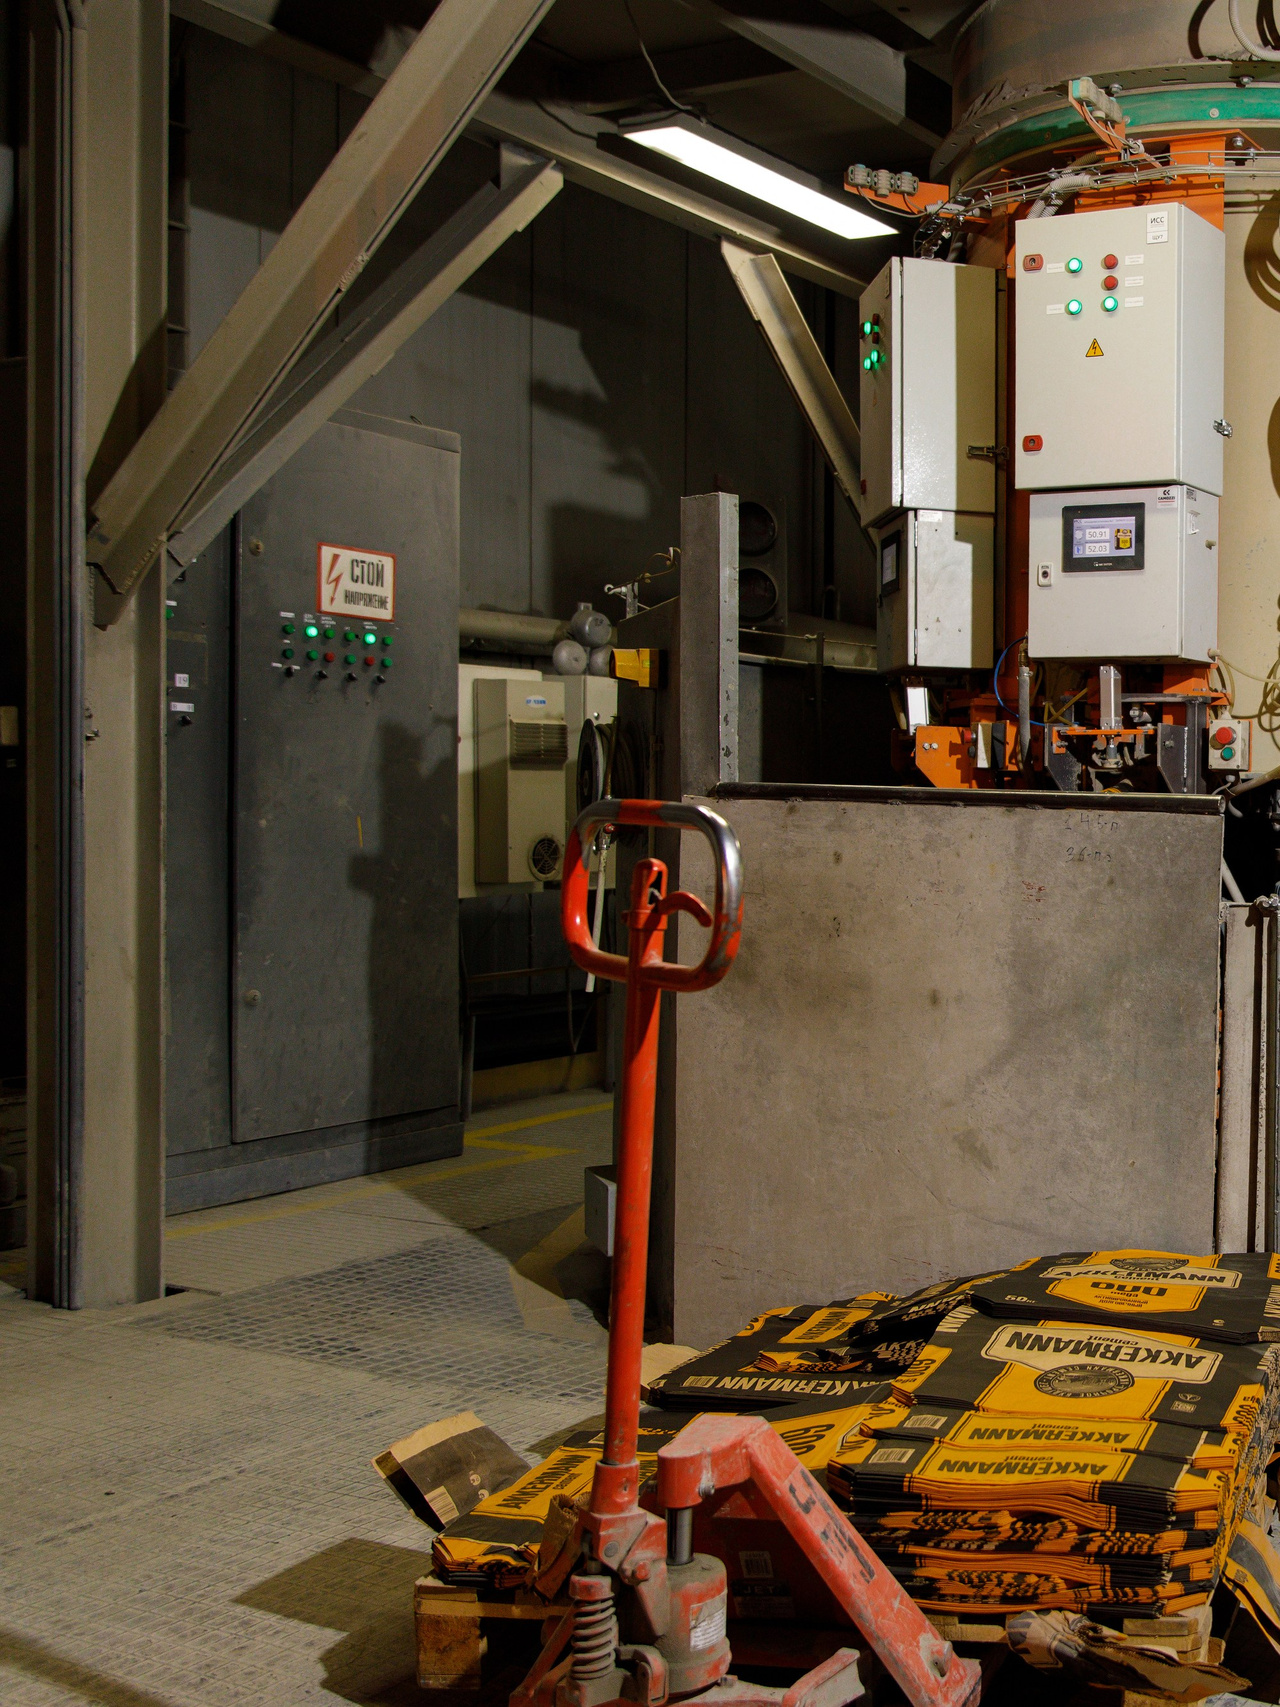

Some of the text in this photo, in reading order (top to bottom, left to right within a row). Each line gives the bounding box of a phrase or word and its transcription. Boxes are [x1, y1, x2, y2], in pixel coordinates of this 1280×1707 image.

[1088, 531, 1107, 539] 50.91
[351, 558, 385, 588] СТОЙ
[344, 589, 389, 611] НАПРЯЖЕНИЕ
[1086, 1334, 1140, 1347] cement
[1005, 1331, 1208, 1370] AKKERMANN
[967, 1427, 1131, 1444] AKKERMANN
[1031, 1423, 1080, 1431] cement
[937, 1458, 1111, 1476] AKKERMANN
[1003, 1455, 1055, 1463] cement
[496, 1454, 591, 1510] AKKERMANN
